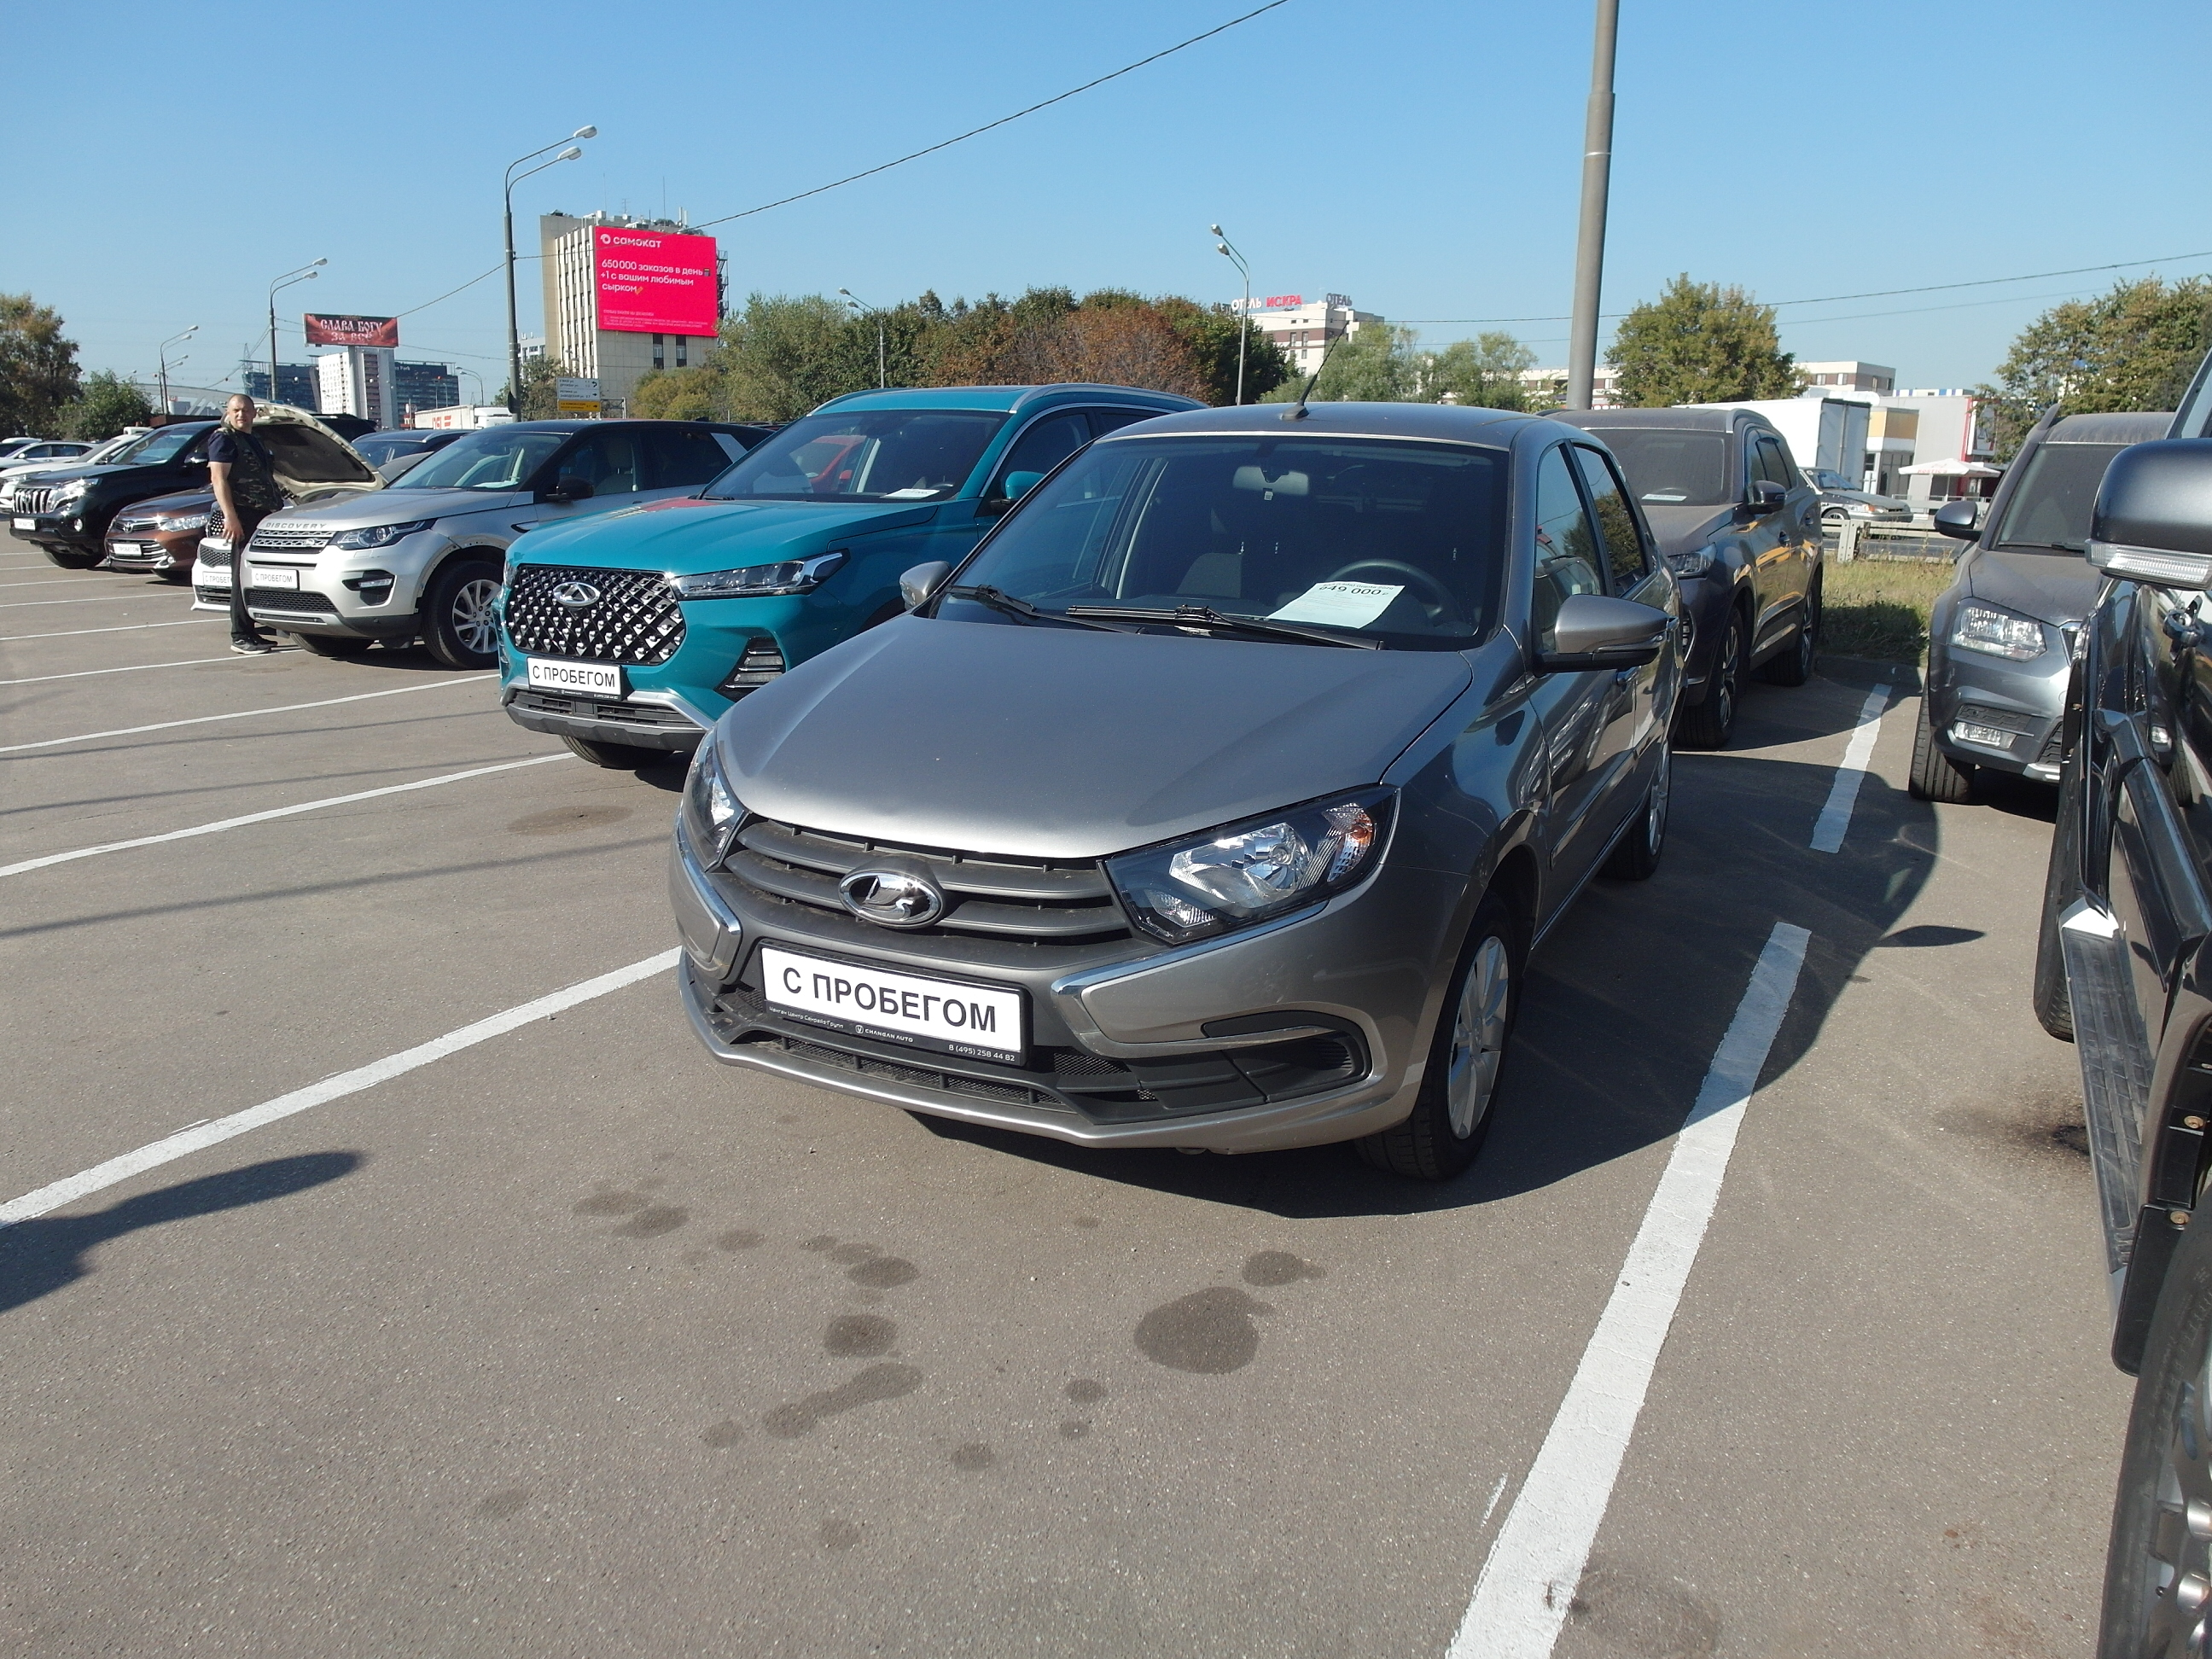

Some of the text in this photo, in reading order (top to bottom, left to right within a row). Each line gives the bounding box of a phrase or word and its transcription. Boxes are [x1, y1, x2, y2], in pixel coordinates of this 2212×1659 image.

[613, 236, 661, 248] самокат
[638, 264, 673, 273] заказов
[601, 271, 609, 279] +1
[618, 274, 649, 282] вашим
[650, 275, 694, 286] любимым
[602, 282, 637, 293] сырком
[1266, 294, 1302, 307] ИСКРА
[1326, 293, 1353, 306] ОТЕЛЬ
[260, 574, 292, 583] ПРОБЕГОМ
[533, 666, 615, 687] С ПРОБЕГОМ
[783, 967, 996, 1033] С ПРОБЕГОМ
[864, 1028, 913, 1043] CHANGAN AUTO
[956, 1045, 975, 1055] (495)
